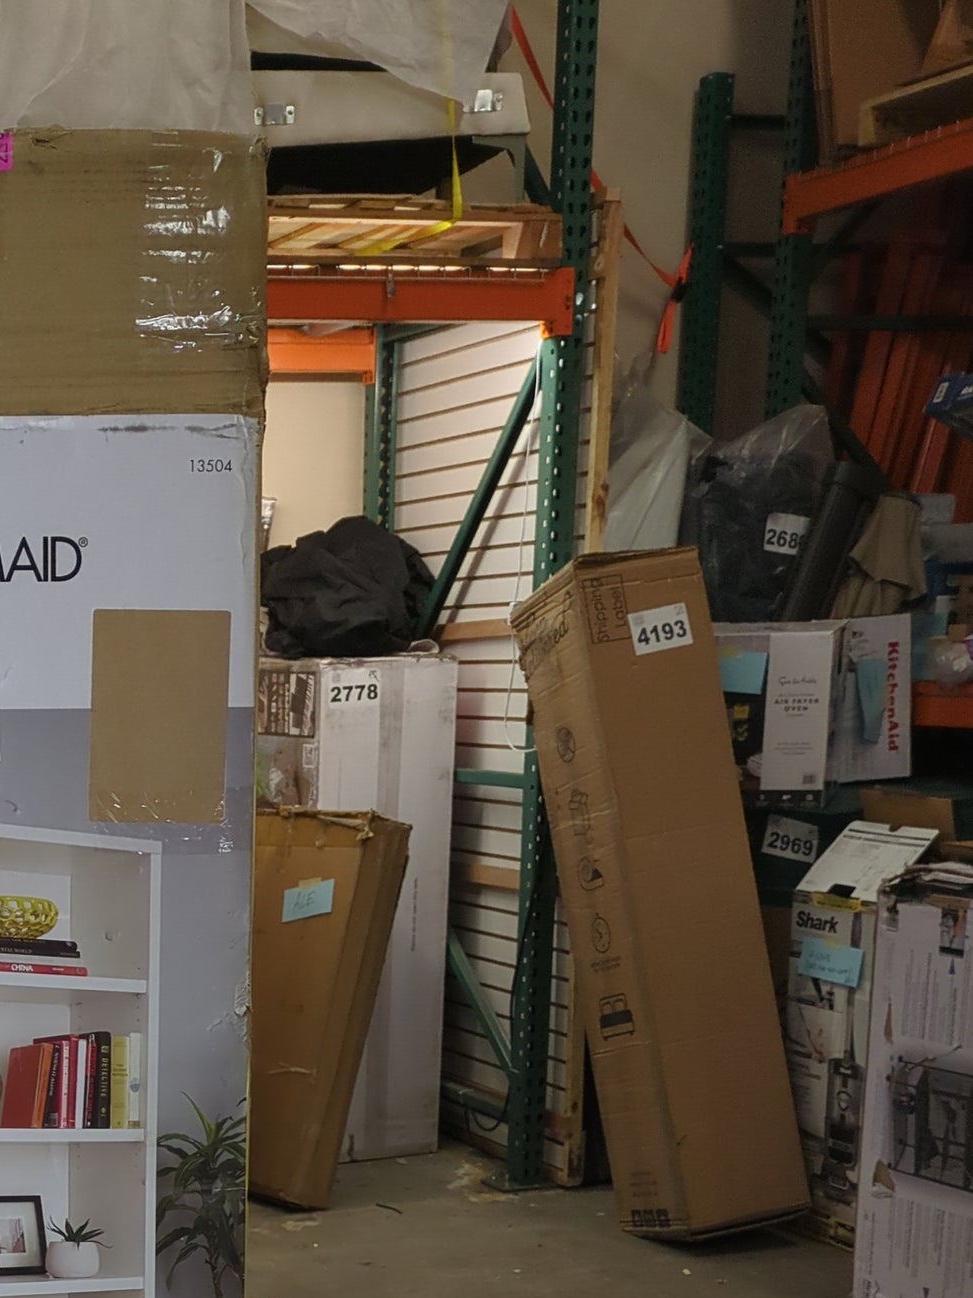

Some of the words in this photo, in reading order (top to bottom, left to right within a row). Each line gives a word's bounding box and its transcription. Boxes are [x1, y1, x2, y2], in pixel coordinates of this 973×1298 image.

[188, 458, 233, 474] 13504
[765, 529, 800, 549] 268
[636, 619, 688, 647] 4193
[330, 683, 379, 703] 2778
[767, 831, 814, 857] 2969
[795, 910, 839, 934] Shark
